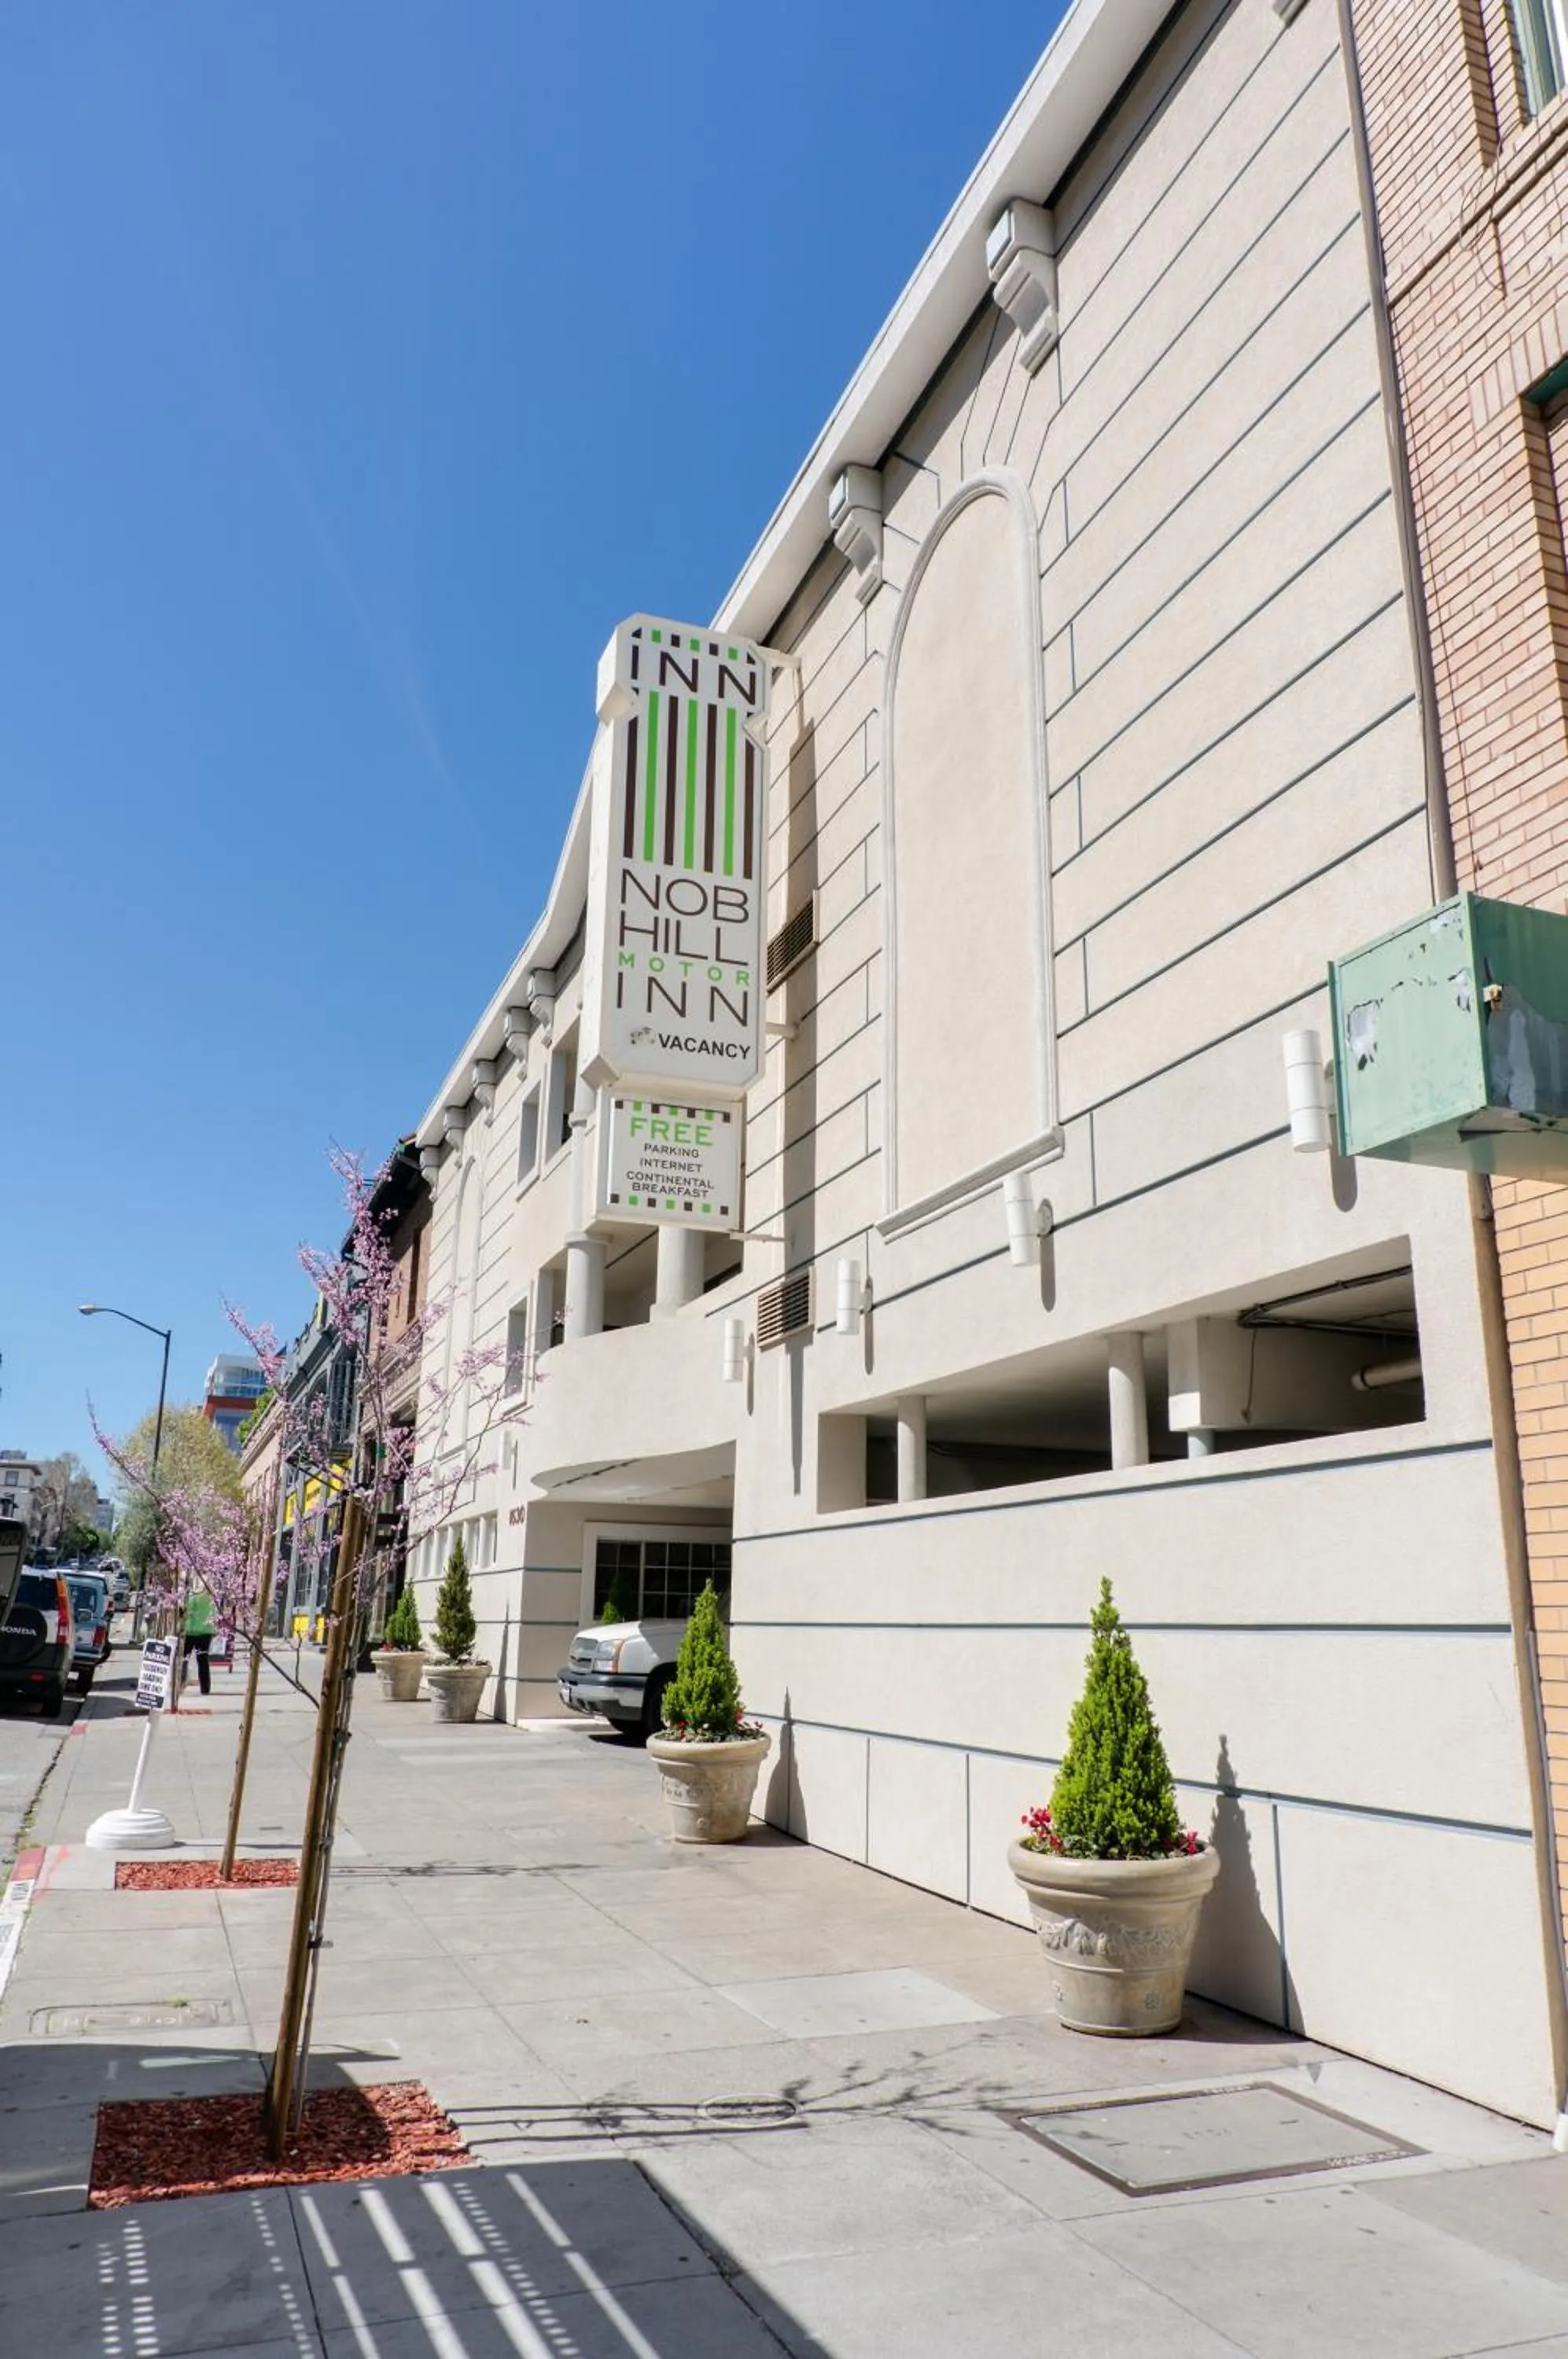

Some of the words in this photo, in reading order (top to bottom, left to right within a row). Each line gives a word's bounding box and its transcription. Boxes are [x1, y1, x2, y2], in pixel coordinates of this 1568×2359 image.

[631, 644, 756, 706] INN
[621, 868, 749, 924] NOB
[619, 910, 749, 966] HILL
[618, 951, 750, 986] MOTOR
[617, 971, 749, 1027] INN
[658, 1032, 751, 1060] VACANCY
[630, 1117, 713, 1146] FREE
[639, 1157, 702, 1172] INTERNET
[644, 1143, 700, 1158] PARKING
[626, 1171, 715, 1190] CONTINENTAL
[631, 1182, 709, 1199] BREAKFAST
